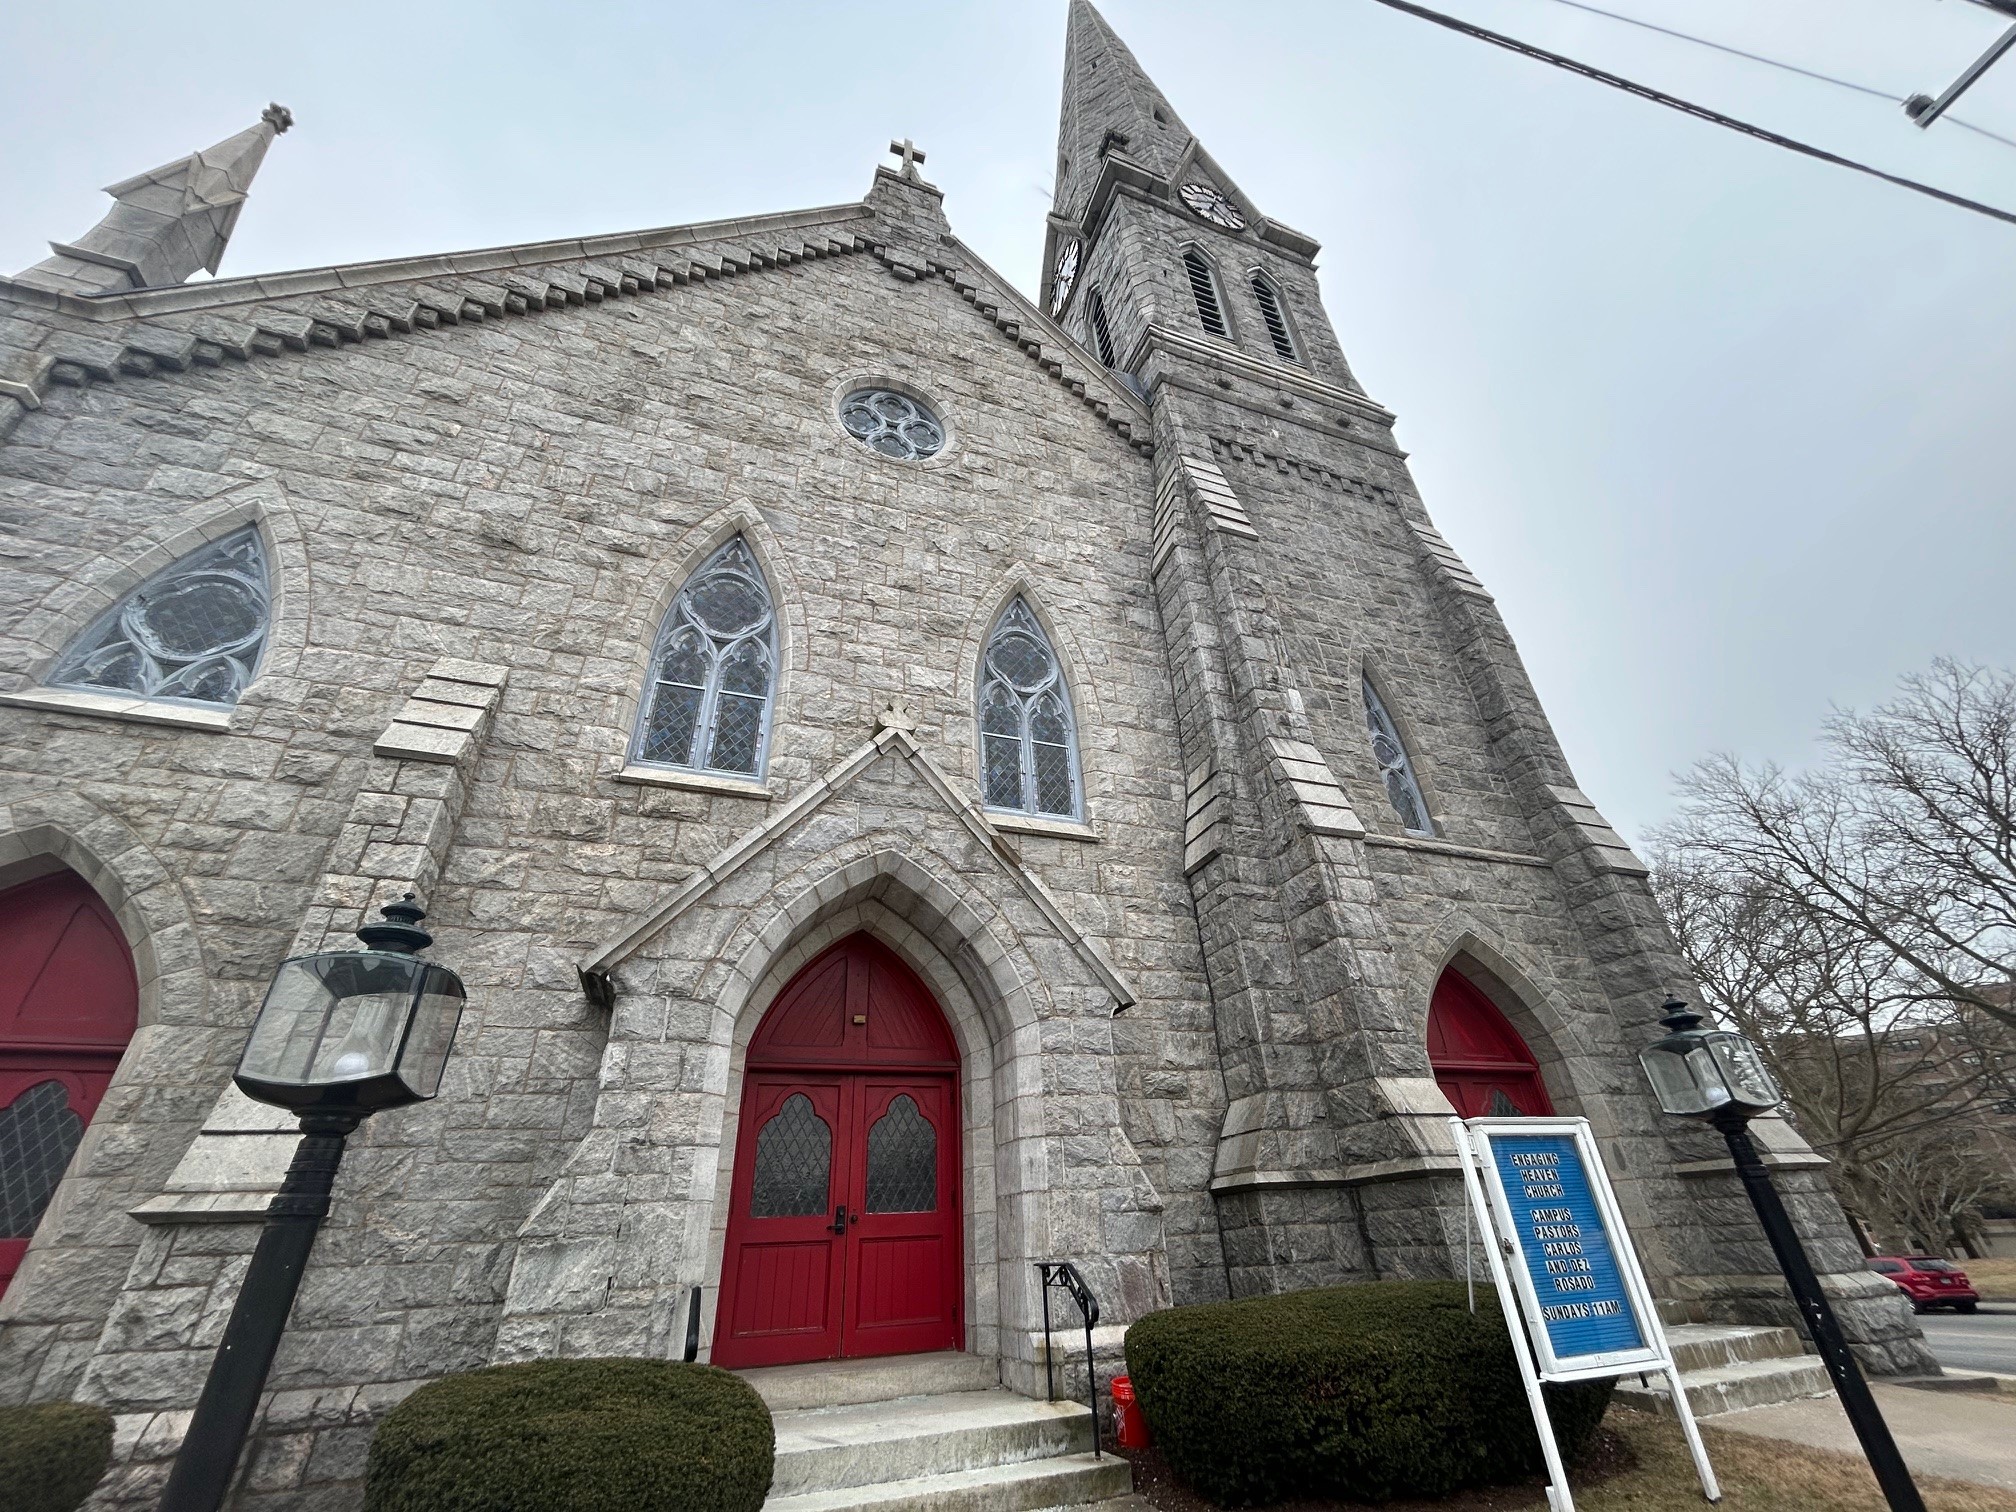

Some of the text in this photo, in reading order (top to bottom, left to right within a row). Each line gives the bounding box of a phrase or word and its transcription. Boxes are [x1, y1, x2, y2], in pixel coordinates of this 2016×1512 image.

[1511, 1153, 1559, 1166] ENGAGING
[1521, 1169, 1559, 1182] HEAVEN
[1524, 1185, 1564, 1198] CHURCH
[1531, 1208, 1571, 1222] CAMPUS
[1534, 1225, 1580, 1239] PASTORS
[1544, 1242, 1582, 1256] CARLOS
[1548, 1259, 1590, 1273] AND DEZ
[1555, 1276, 1594, 1291] ROSADO
[1543, 1300, 1620, 1320] SUNDAYS 11AM
